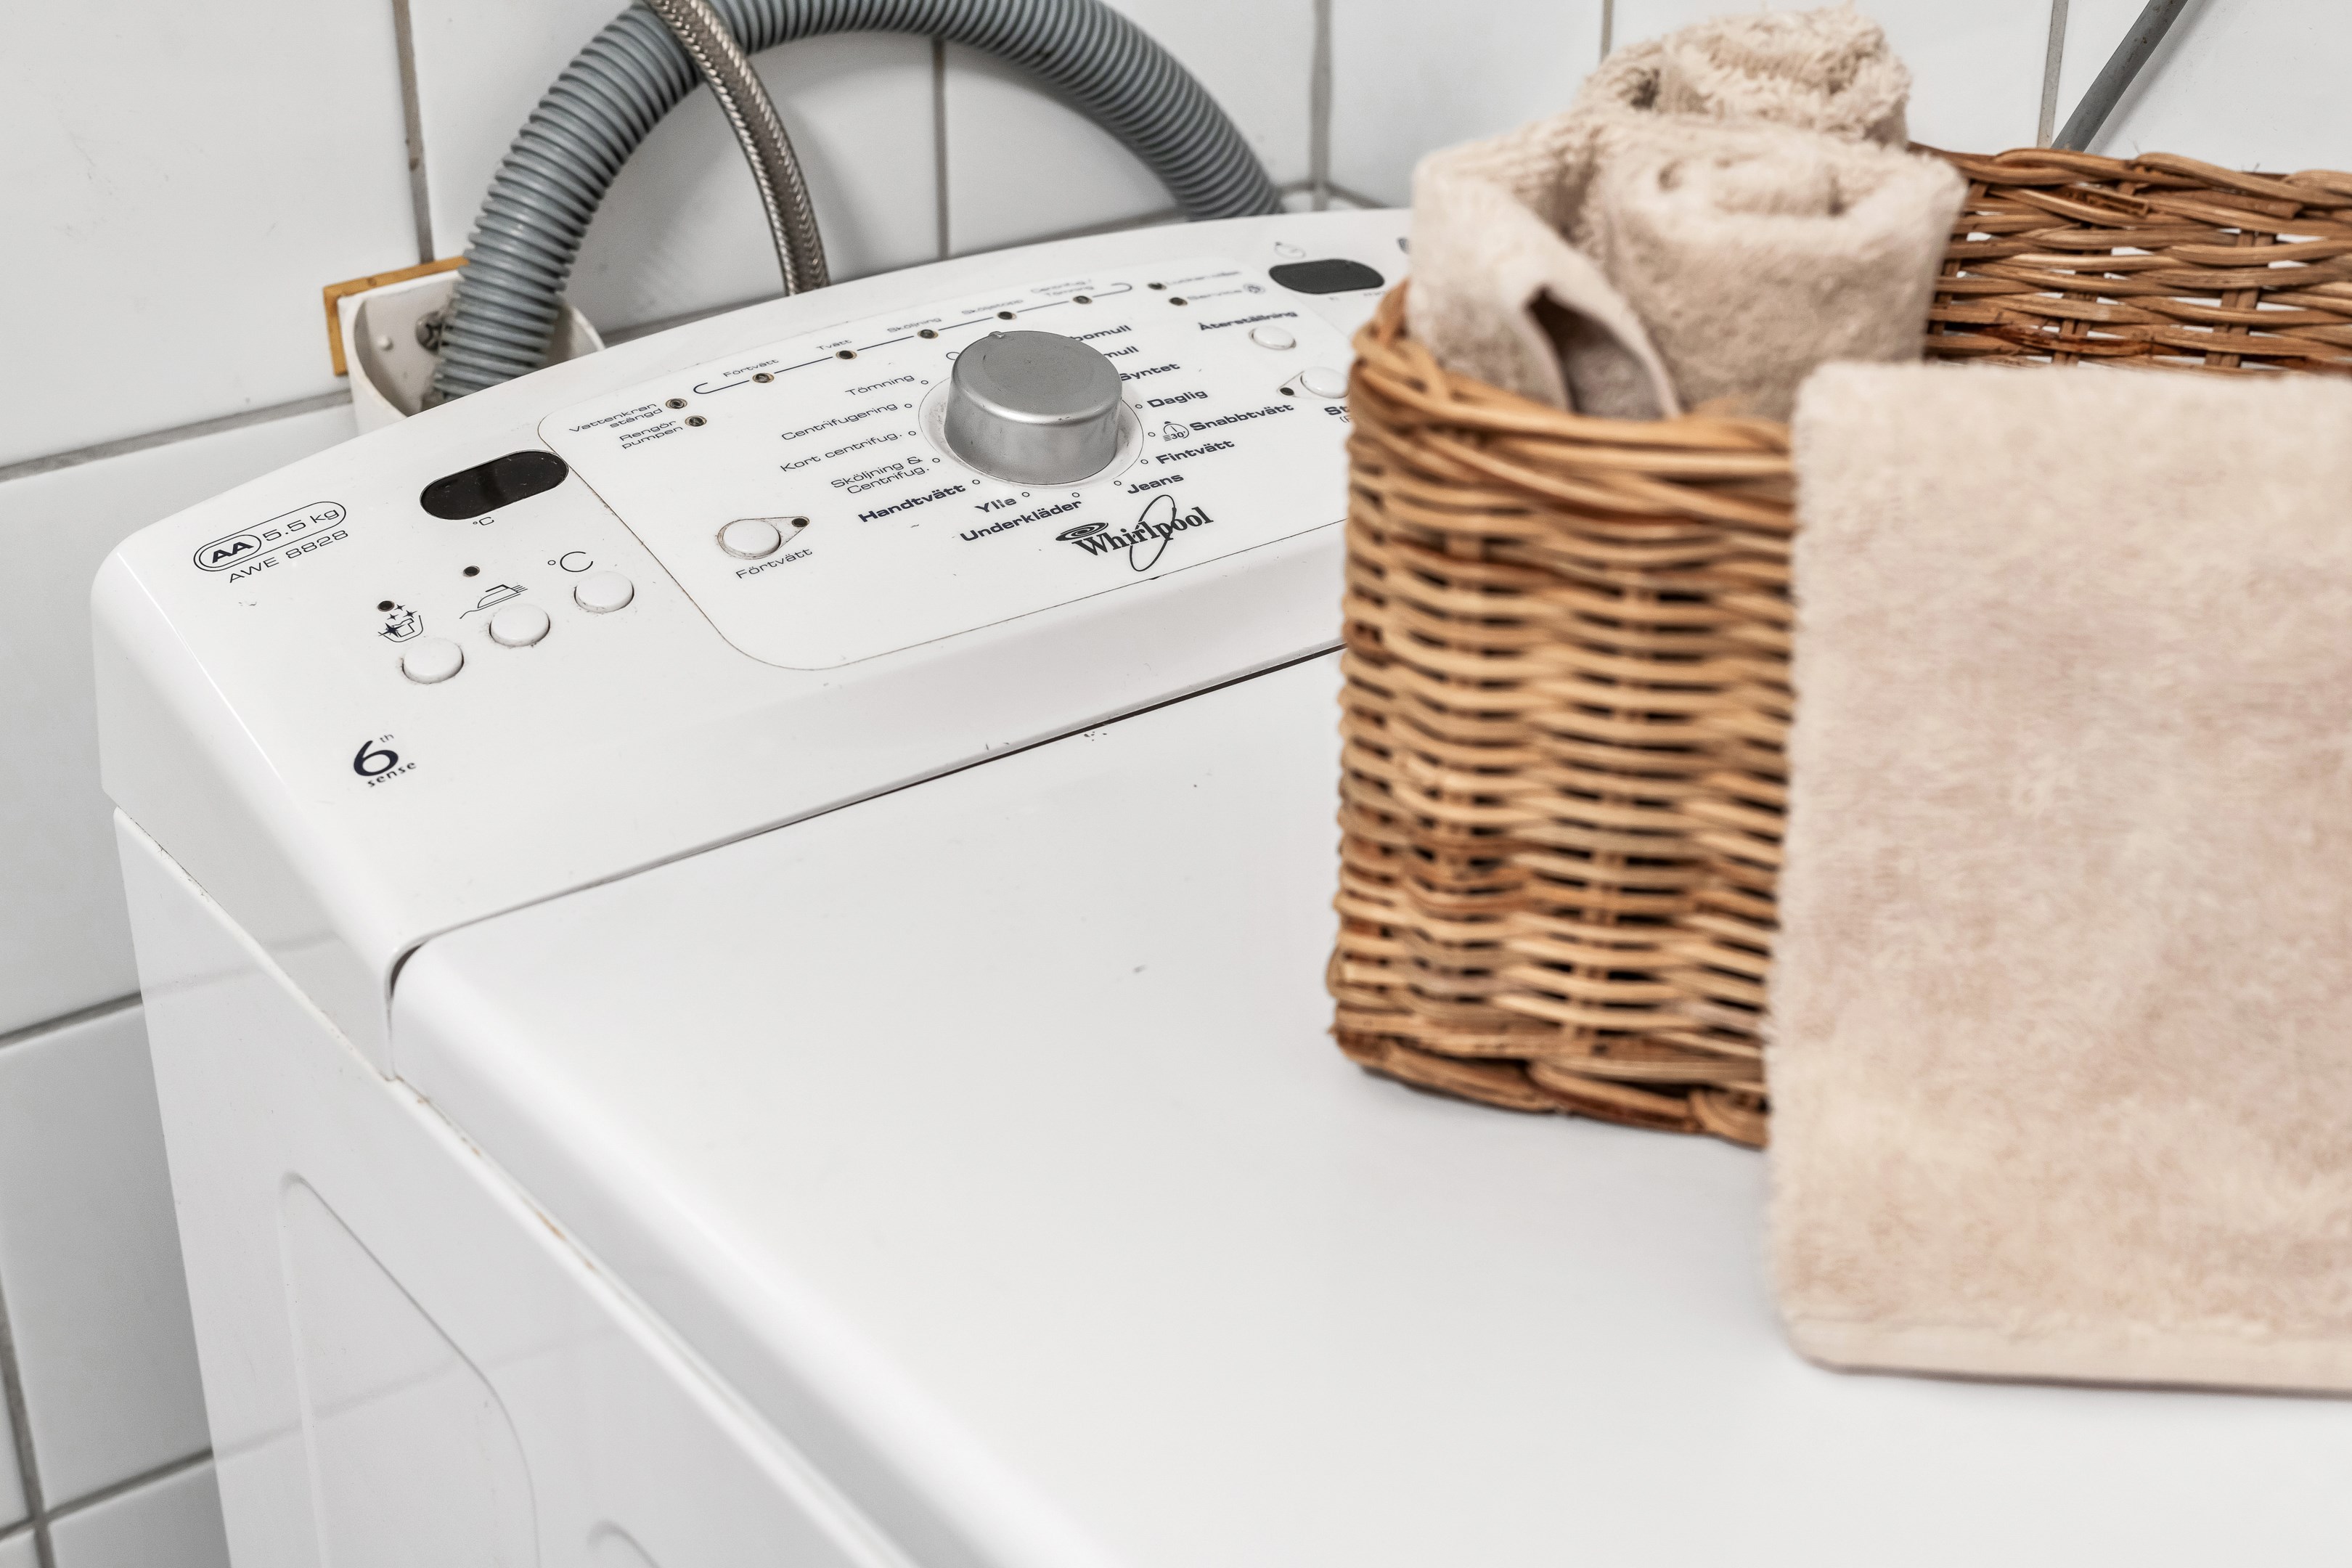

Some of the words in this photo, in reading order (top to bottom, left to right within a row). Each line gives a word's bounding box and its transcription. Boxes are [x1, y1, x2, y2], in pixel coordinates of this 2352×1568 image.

[815, 338, 852, 350] Tvätt
[722, 359, 780, 377] Förtvätt
[1119, 363, 1180, 381] Syntet
[844, 375, 915, 396] Tömning
[1146, 390, 1209, 408] Daglig
[568, 403, 657, 432] Vattenkran
[609, 408, 663, 428] stängd
[618, 420, 677, 441] Rengör
[781, 403, 898, 441] Centrifugering
[1189, 404, 1295, 431] Snabbtvätt
[621, 425, 684, 449] pumpen
[780, 455, 821, 473] Kort
[824, 431, 902, 459] centrifug.
[1155, 440, 1236, 465] Fintvätt
[830, 462, 905, 489] Sköljning
[907, 456, 923, 465] &
[846, 466, 930, 494] Centrifug.
[1127, 474, 1185, 494] Jeans
[858, 483, 966, 523] Handtvätt
[960, 499, 1082, 542] Underkläder
[1071, 506, 1214, 557] Whirlpool
[212, 542, 254, 564] AA
[262, 519, 307, 542] 5.5
[309, 509, 340, 523] kg
[229, 557, 279, 584] AWE
[285, 530, 348, 559] 8828
[735, 549, 813, 579] Förtvätt
[367, 762, 417, 788] sense
